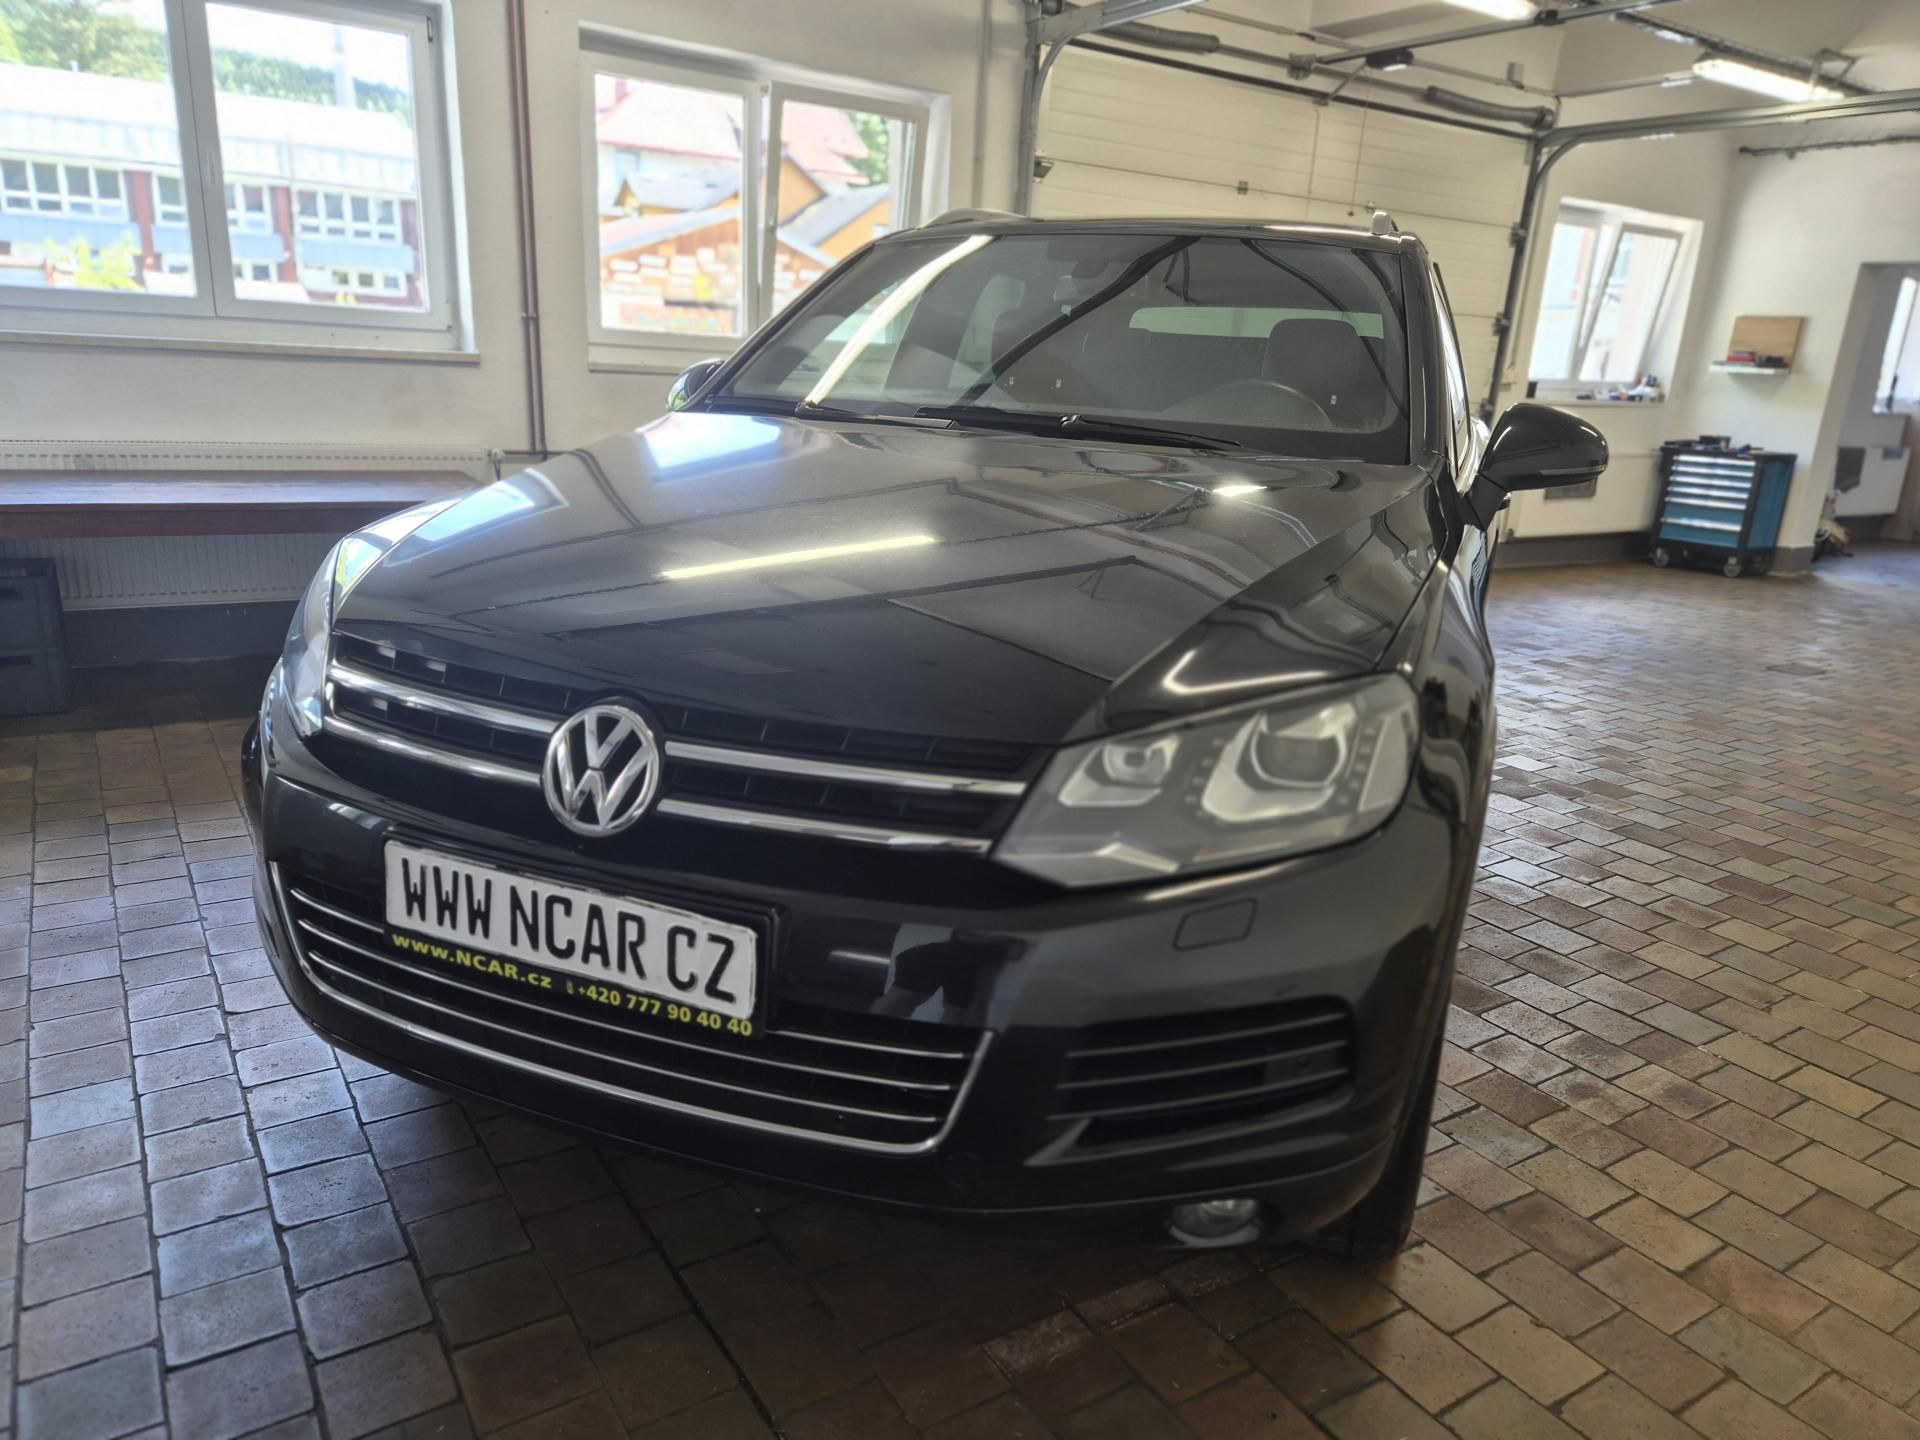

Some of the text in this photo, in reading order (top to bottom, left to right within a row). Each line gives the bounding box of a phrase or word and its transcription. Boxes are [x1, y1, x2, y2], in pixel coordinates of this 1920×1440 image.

[401, 857, 738, 1004] WWW NCAR CZ
[391, 932, 553, 989] www.NCAR.cz
[626, 994, 662, 1017] 777
[666, 1003, 692, 1024] 90
[696, 1009, 722, 1030] 40
[726, 1017, 753, 1037] 40
